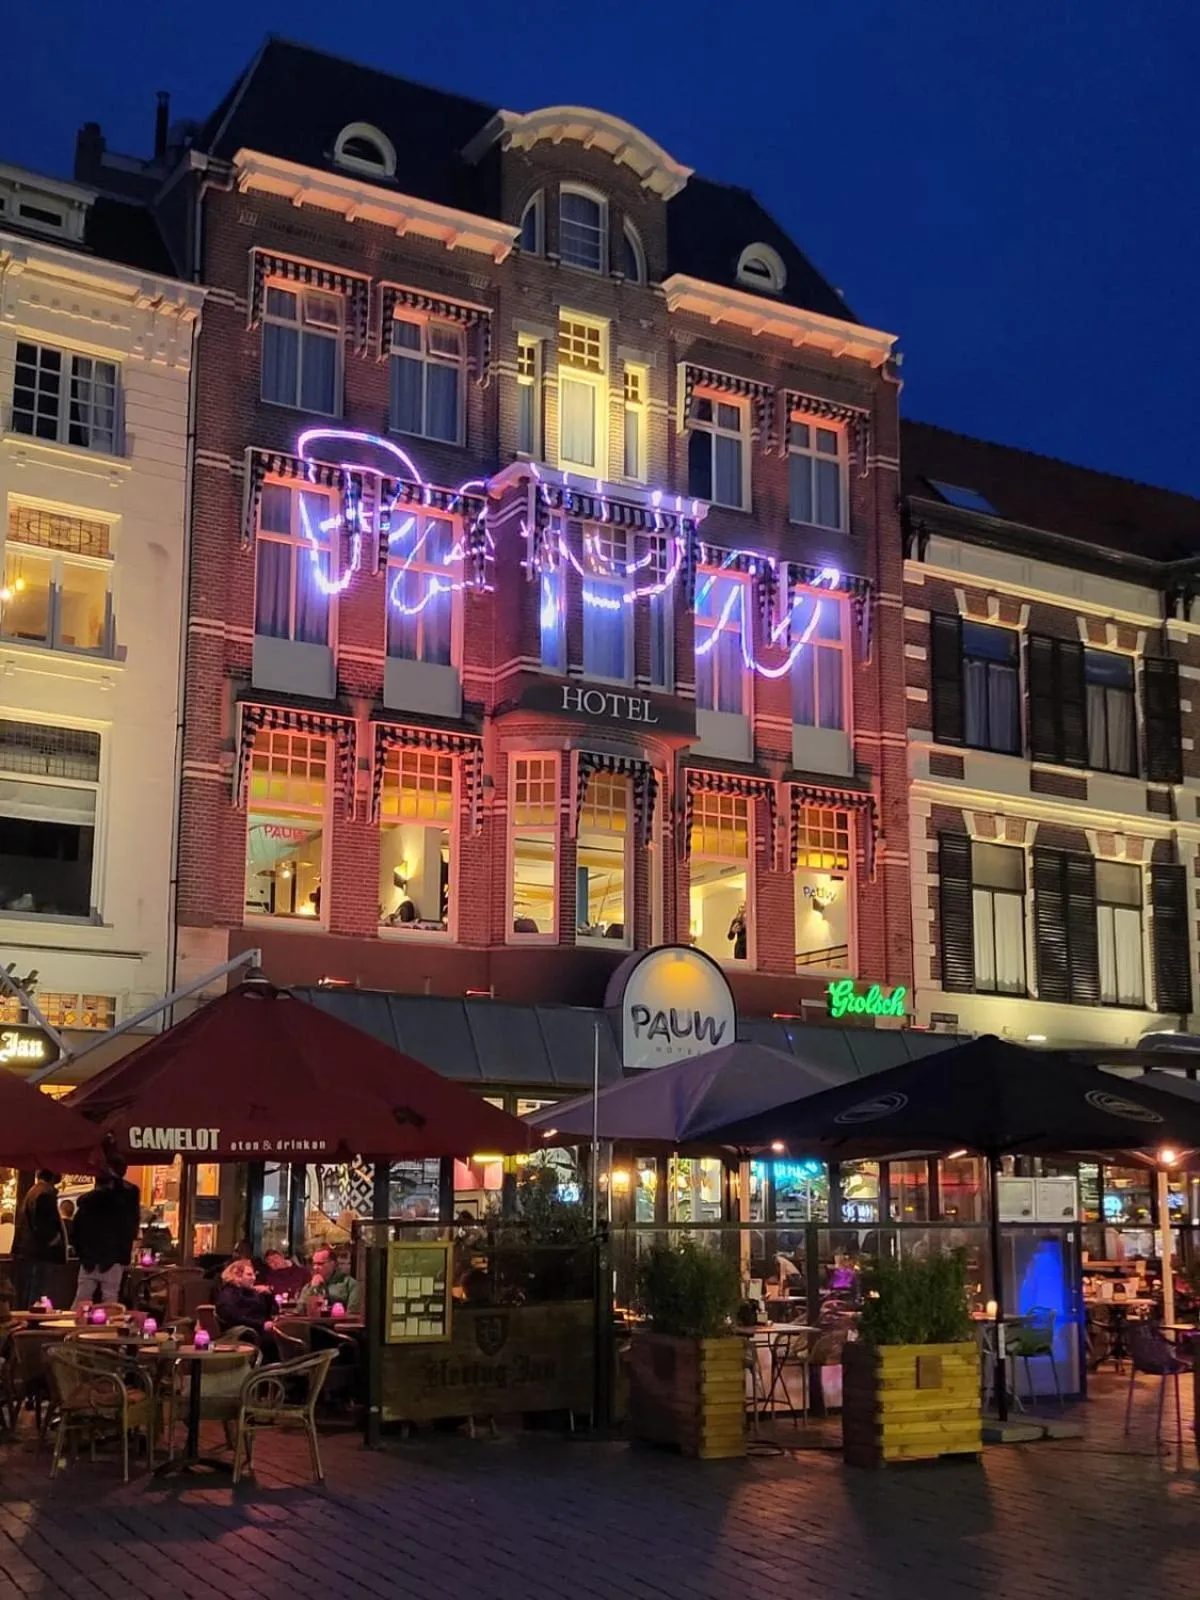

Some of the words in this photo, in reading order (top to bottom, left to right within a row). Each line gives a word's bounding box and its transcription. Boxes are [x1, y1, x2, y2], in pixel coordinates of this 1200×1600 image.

[561, 685, 659, 723] HOTEL
[828, 979, 906, 1017] Grolsch
[631, 1004, 726, 1045] PAUW
[0, 1032, 45, 1062] Jan
[129, 1126, 221, 1150] CAMELOT
